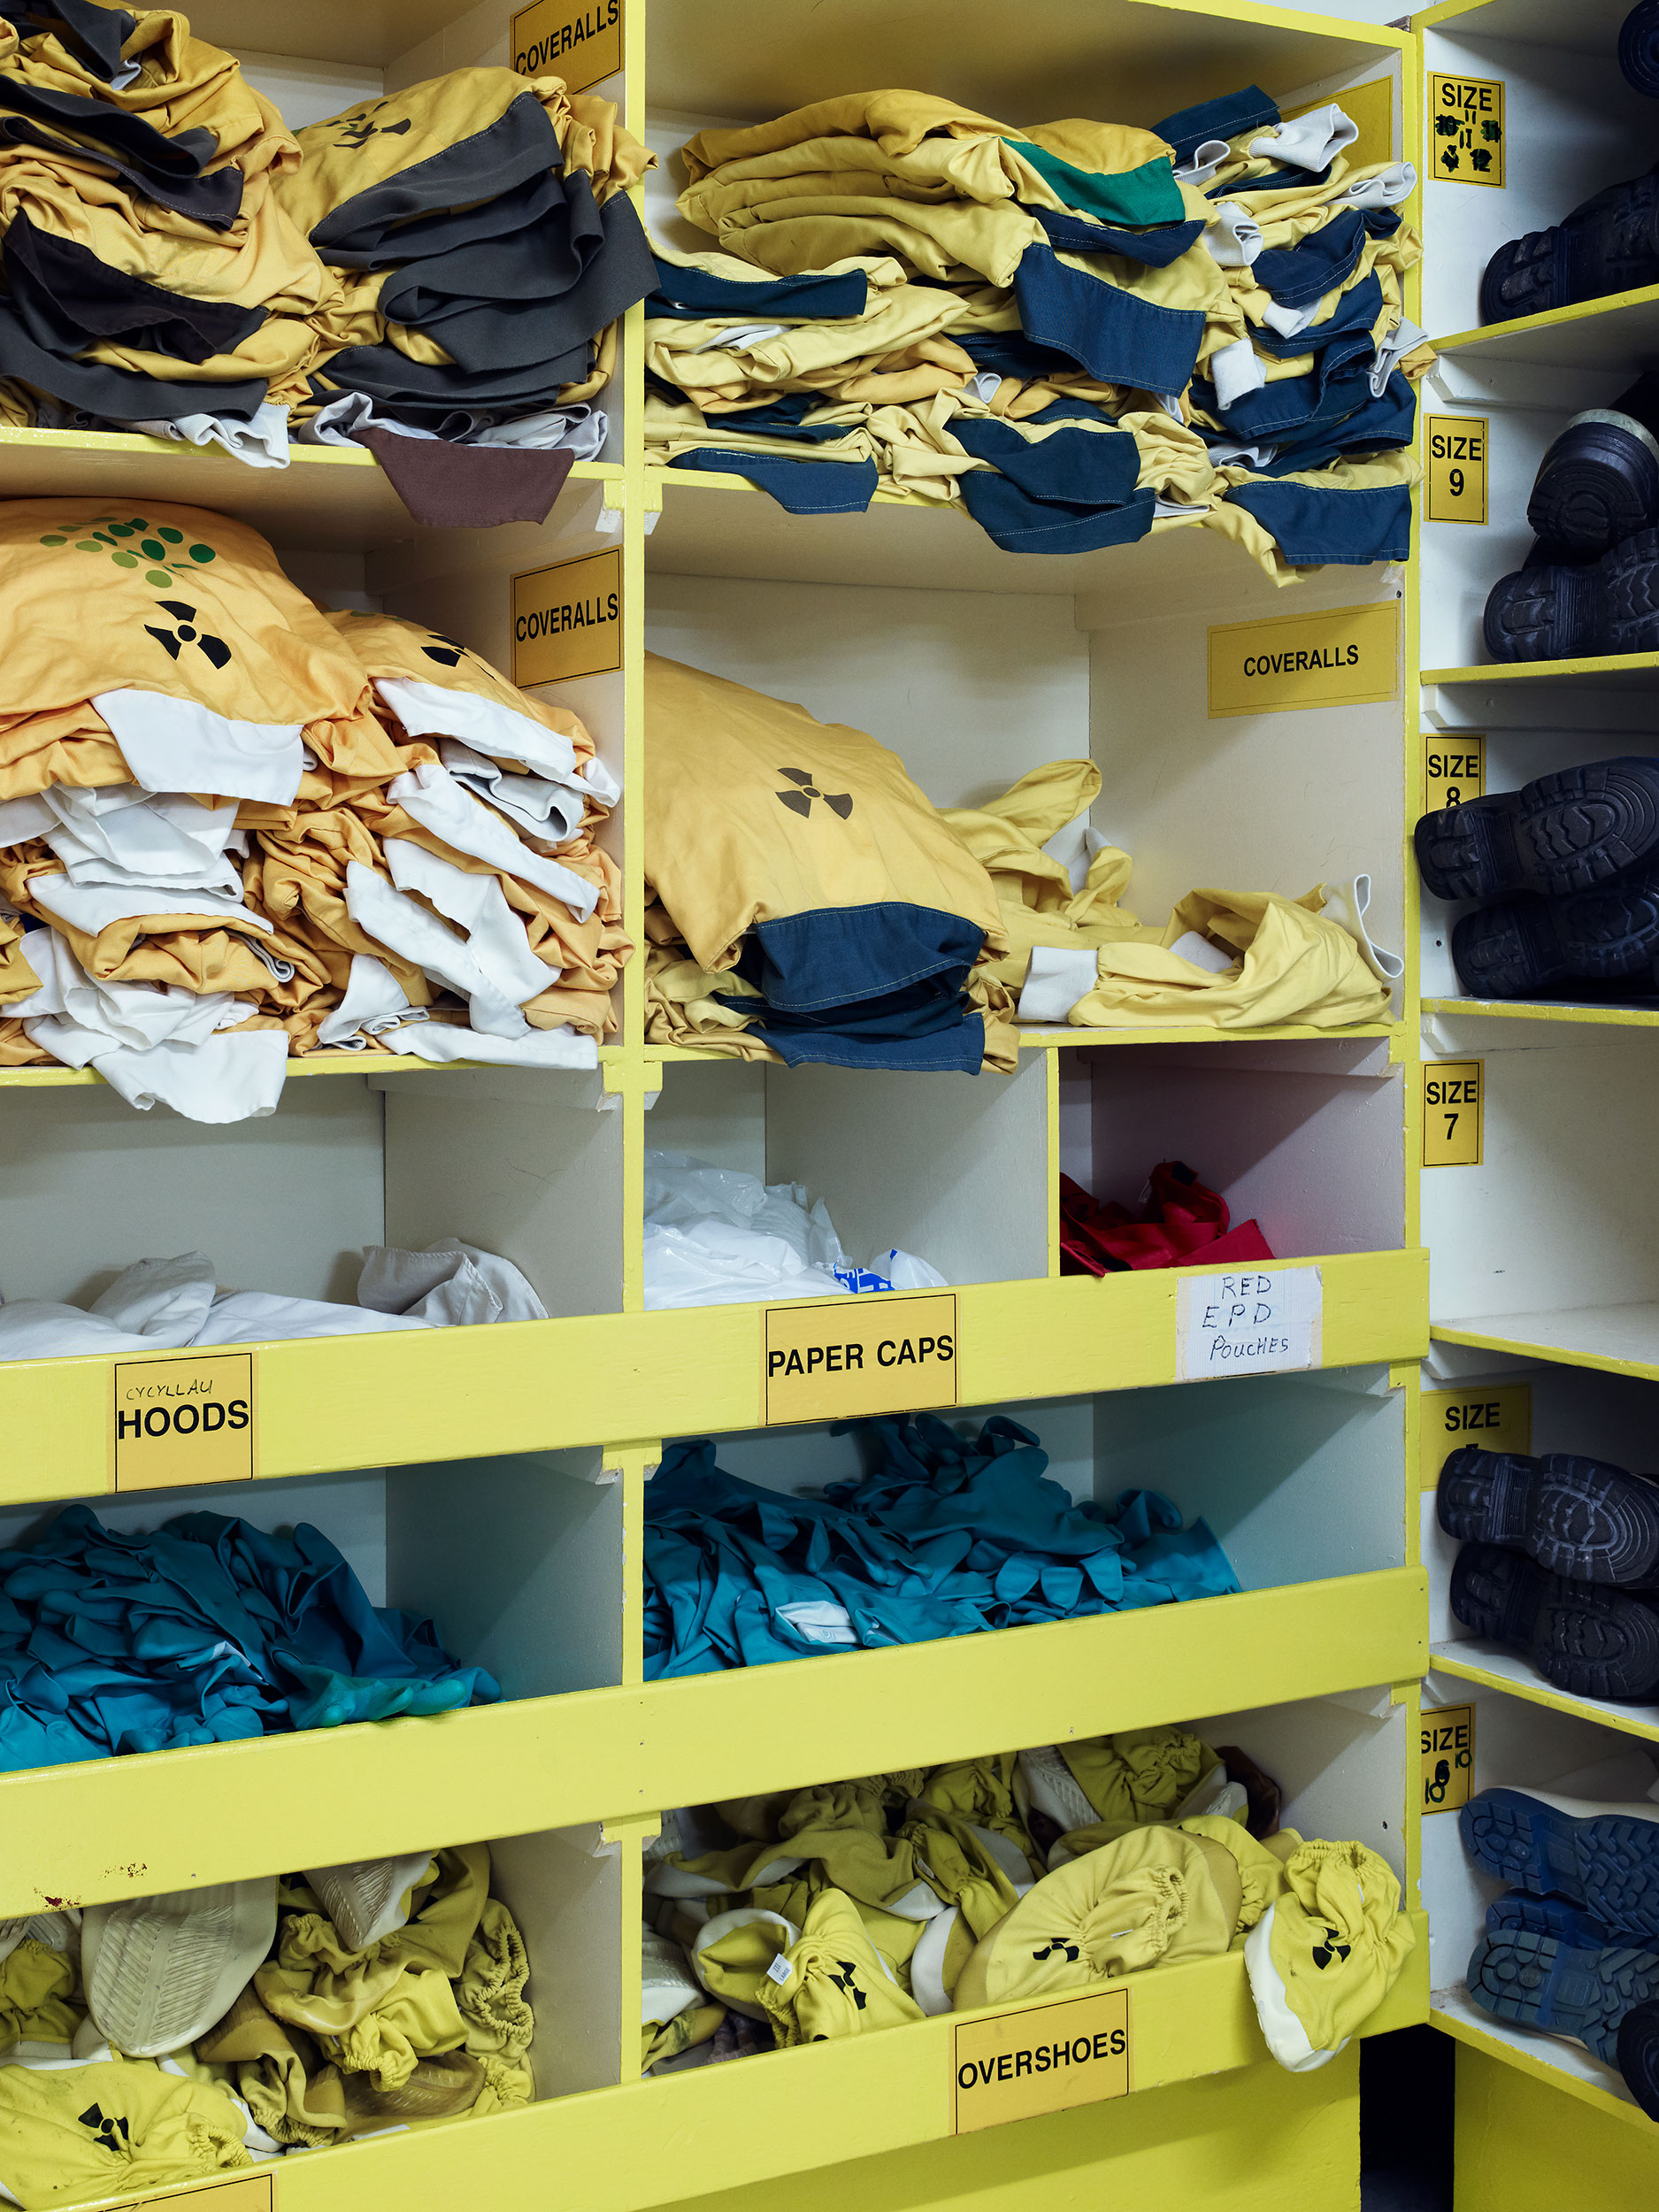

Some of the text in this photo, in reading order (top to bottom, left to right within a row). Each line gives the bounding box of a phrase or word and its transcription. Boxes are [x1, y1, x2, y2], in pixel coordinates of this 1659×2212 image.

[516, 0, 618, 75] COVERALLS
[1441, 82, 1493, 111] SIZE
[1432, 434, 1482, 461] SIZE
[1448, 468, 1464, 496] 9
[516, 593, 618, 642] COVERALLS
[1243, 644, 1359, 677] COVERALLS
[1428, 754, 1479, 779] SIZE
[1446, 786, 1461, 809] 8
[1425, 1080, 1477, 1105] SIZE
[1443, 1112, 1459, 1141] 7
[1221, 1275, 1271, 1300] RED
[768, 1334, 954, 1378] PAPER CAPS
[126, 1379, 213, 1401] CYCYLLAU
[118, 1399, 250, 1440] HOODS
[1444, 1402, 1501, 1432] SIZE
[1420, 1724, 1469, 1755] SIZE
[1425, 1776, 1446, 1805] 10
[957, 2029, 1126, 2090] OVERSHOES
